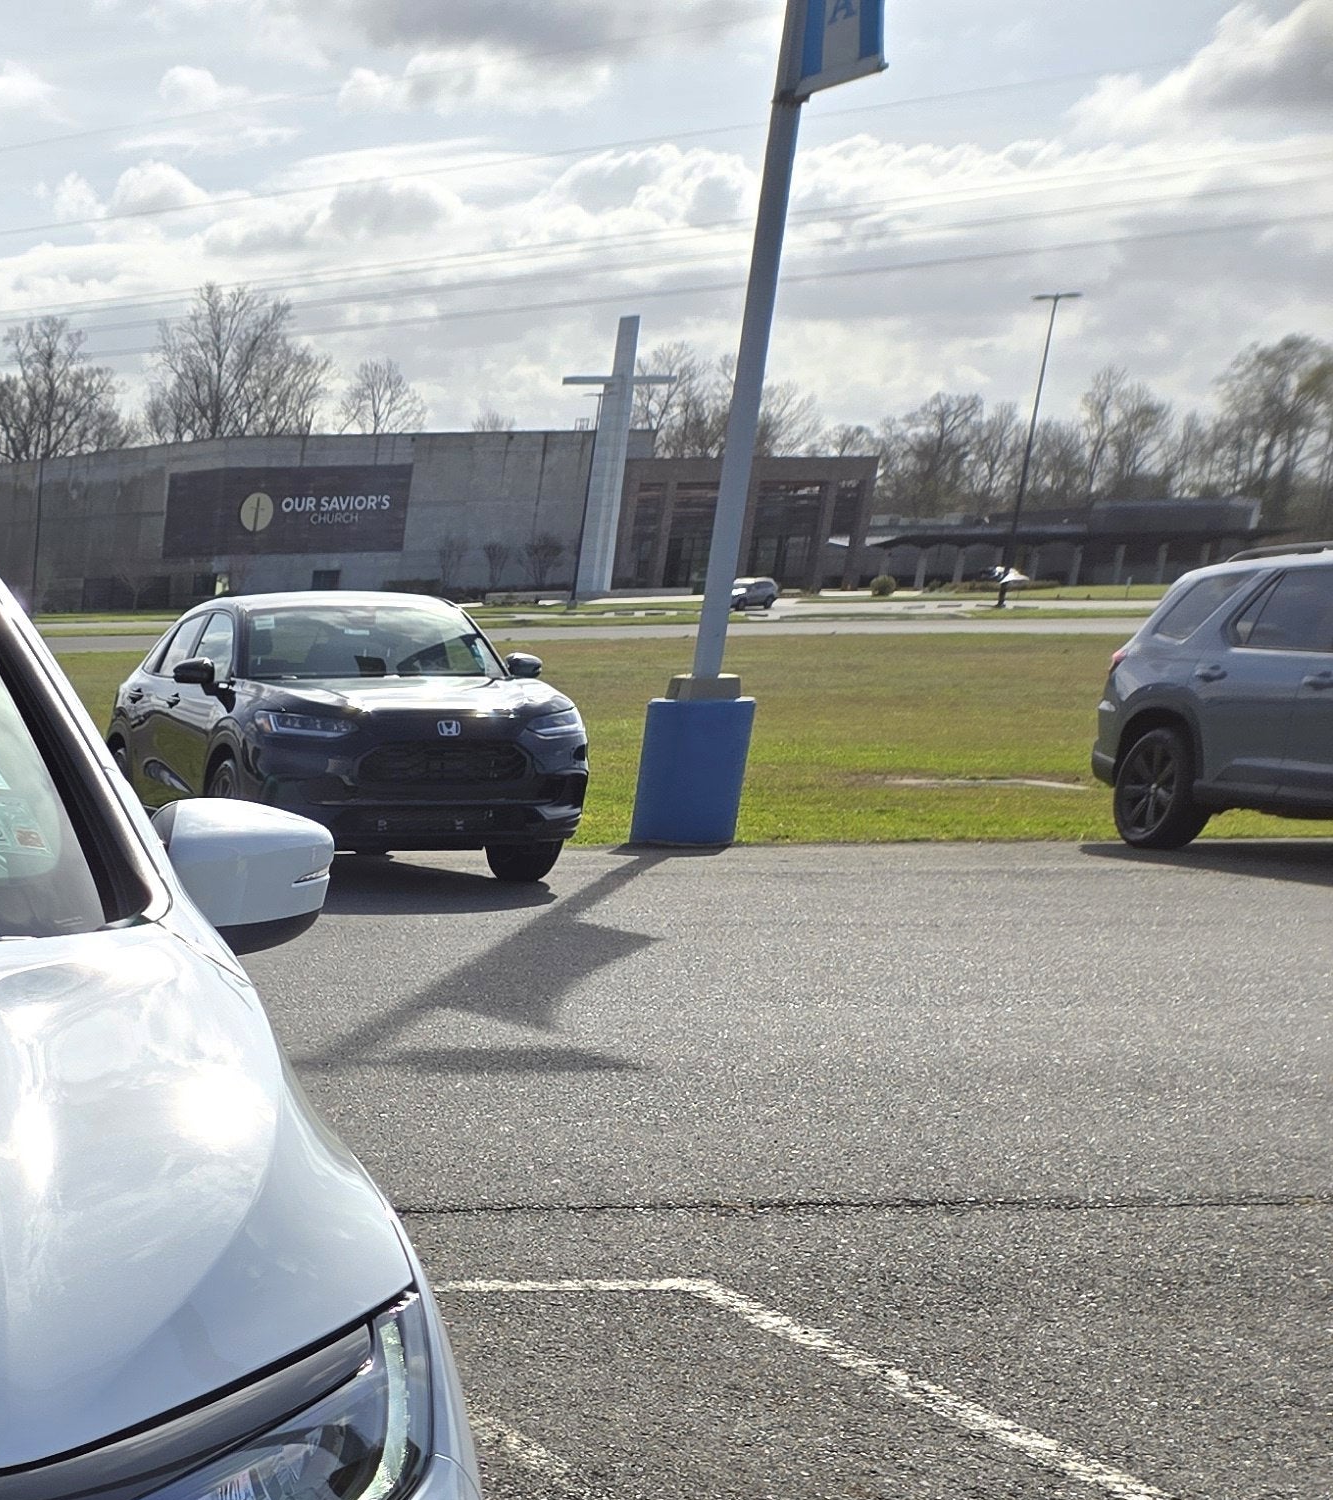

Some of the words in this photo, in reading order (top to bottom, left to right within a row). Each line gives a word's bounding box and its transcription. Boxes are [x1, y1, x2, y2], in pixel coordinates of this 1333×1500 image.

[281, 496, 316, 513] OUR
[320, 494, 391, 512] SAVIOR'S
[310, 512, 359, 525] CHURCH
